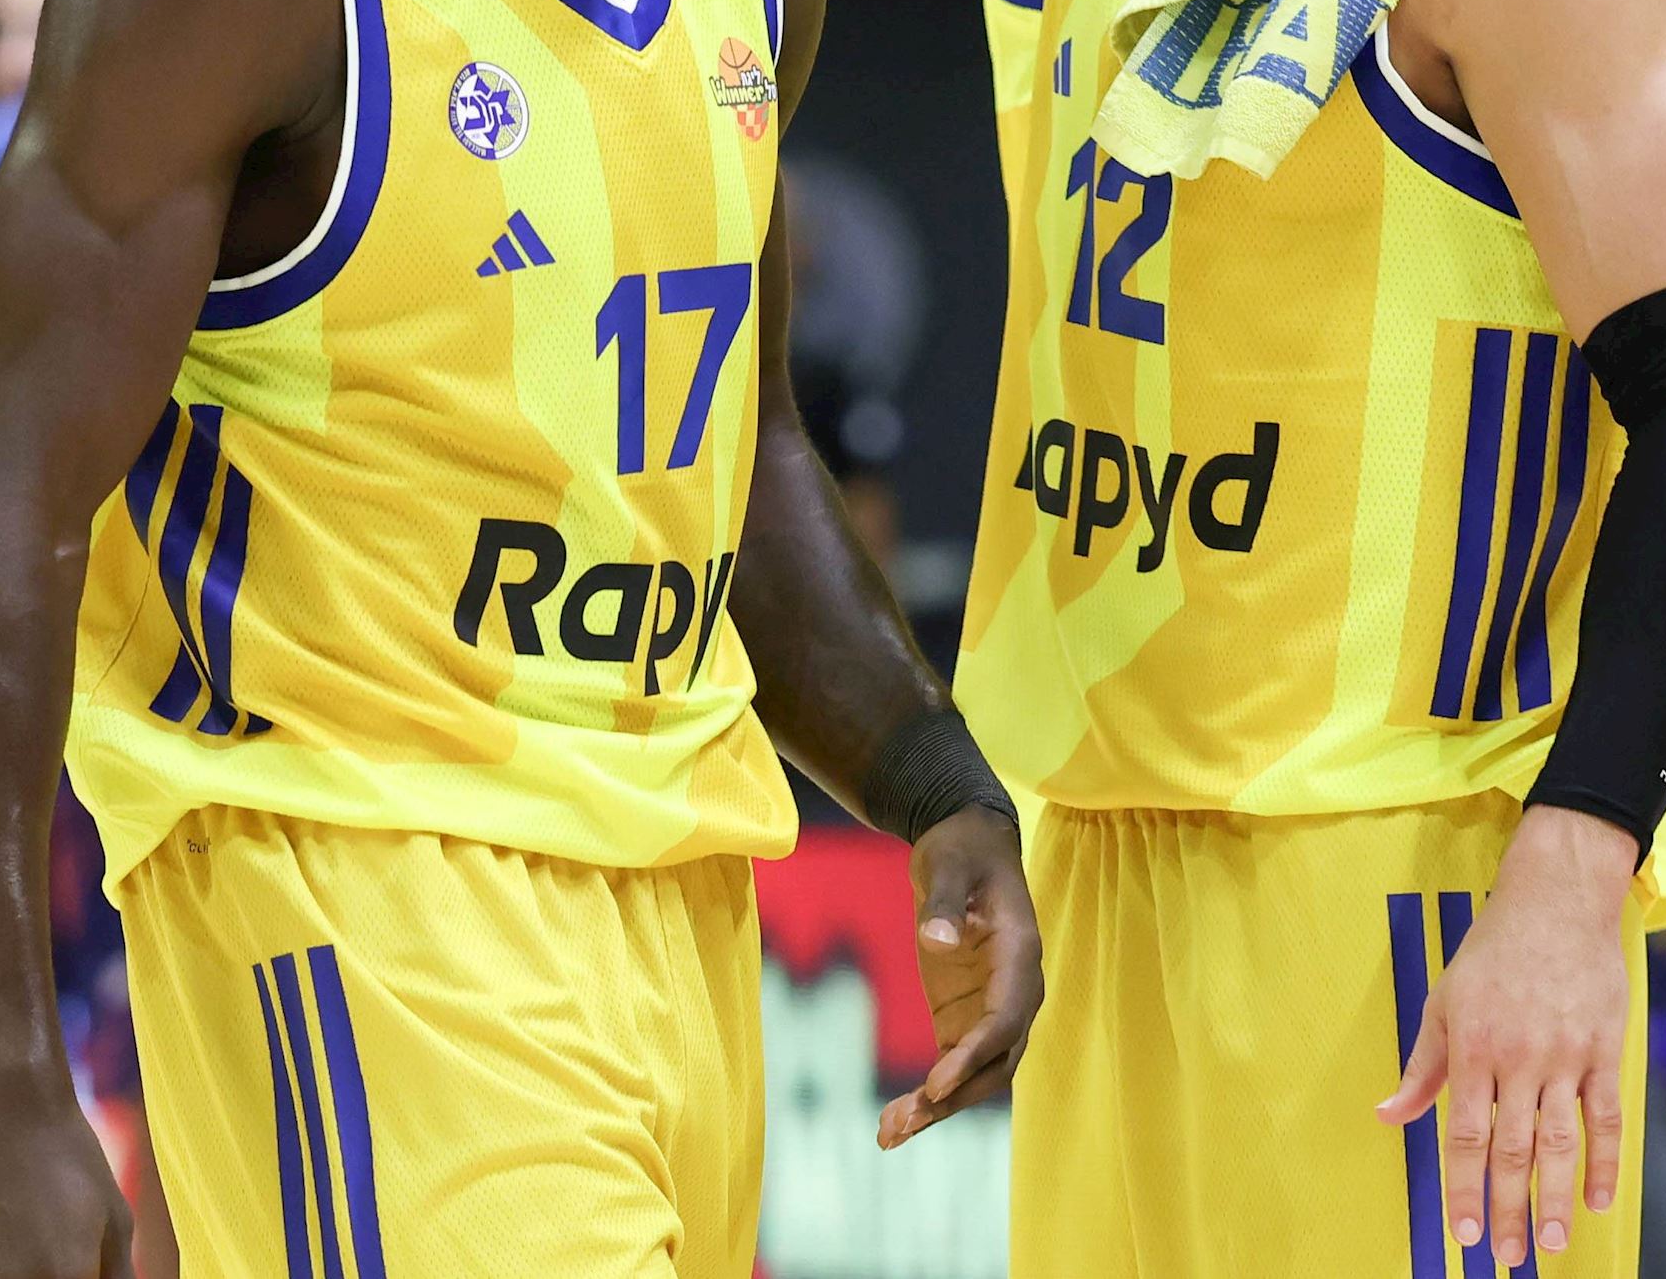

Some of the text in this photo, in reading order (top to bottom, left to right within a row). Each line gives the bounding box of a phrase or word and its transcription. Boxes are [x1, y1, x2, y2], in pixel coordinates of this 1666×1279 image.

[709, 75, 764, 106] Winner
[1065, 137, 1173, 345] 12
[595, 262, 752, 476] 17
[1014, 419, 1280, 573] apyd
[453, 517, 735, 697] Rapy
